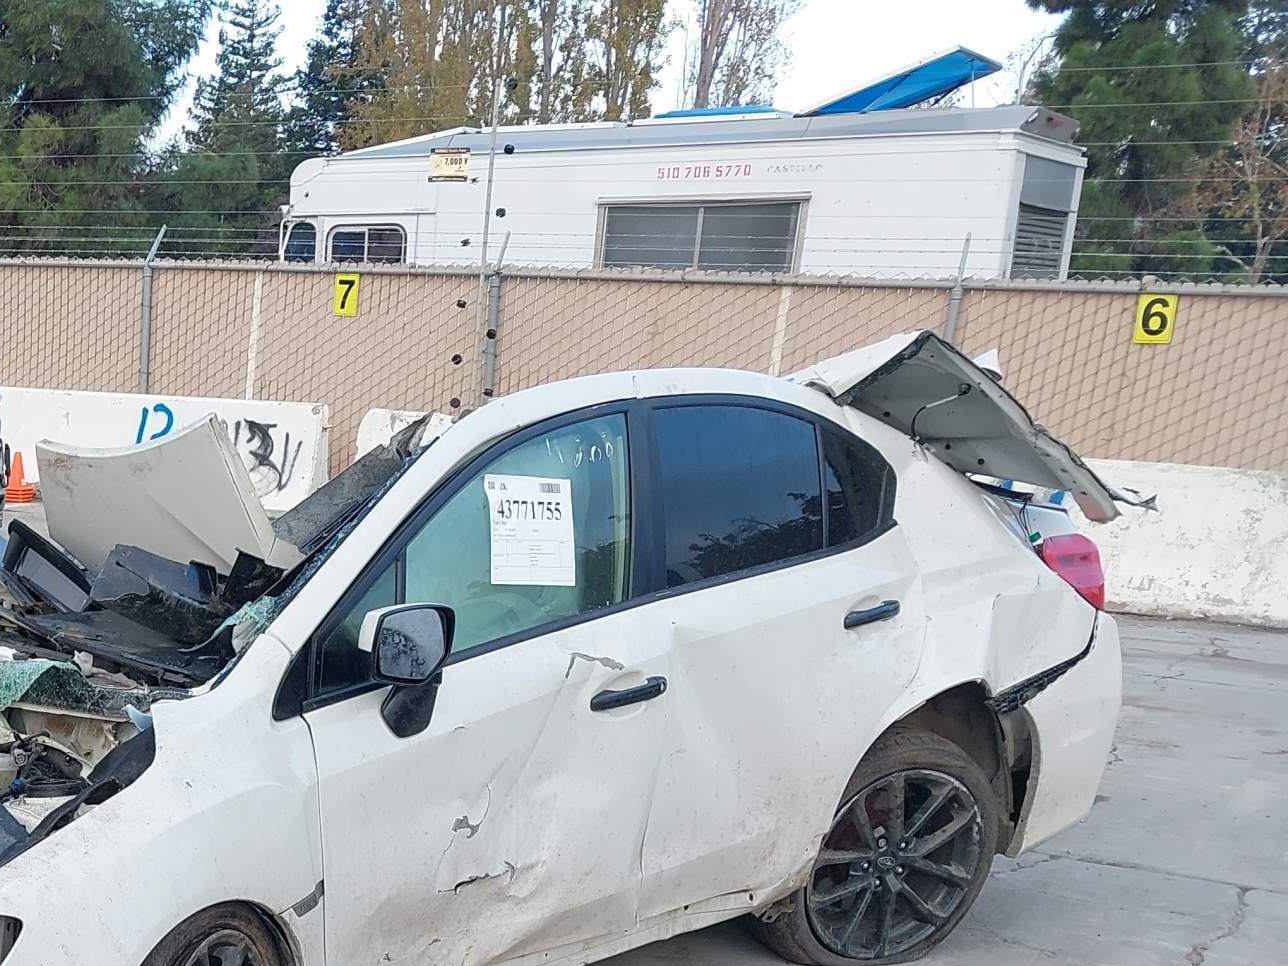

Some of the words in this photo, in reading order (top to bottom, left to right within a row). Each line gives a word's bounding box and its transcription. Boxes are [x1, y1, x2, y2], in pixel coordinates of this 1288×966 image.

[445, 157, 462, 166] 7,000
[657, 167, 680, 181] 510
[685, 166, 711, 180] 706
[715, 164, 752, 179] 5770
[338, 279, 357, 310] 7
[1141, 297, 1171, 337] 6
[497, 498, 563, 521] 43771755
